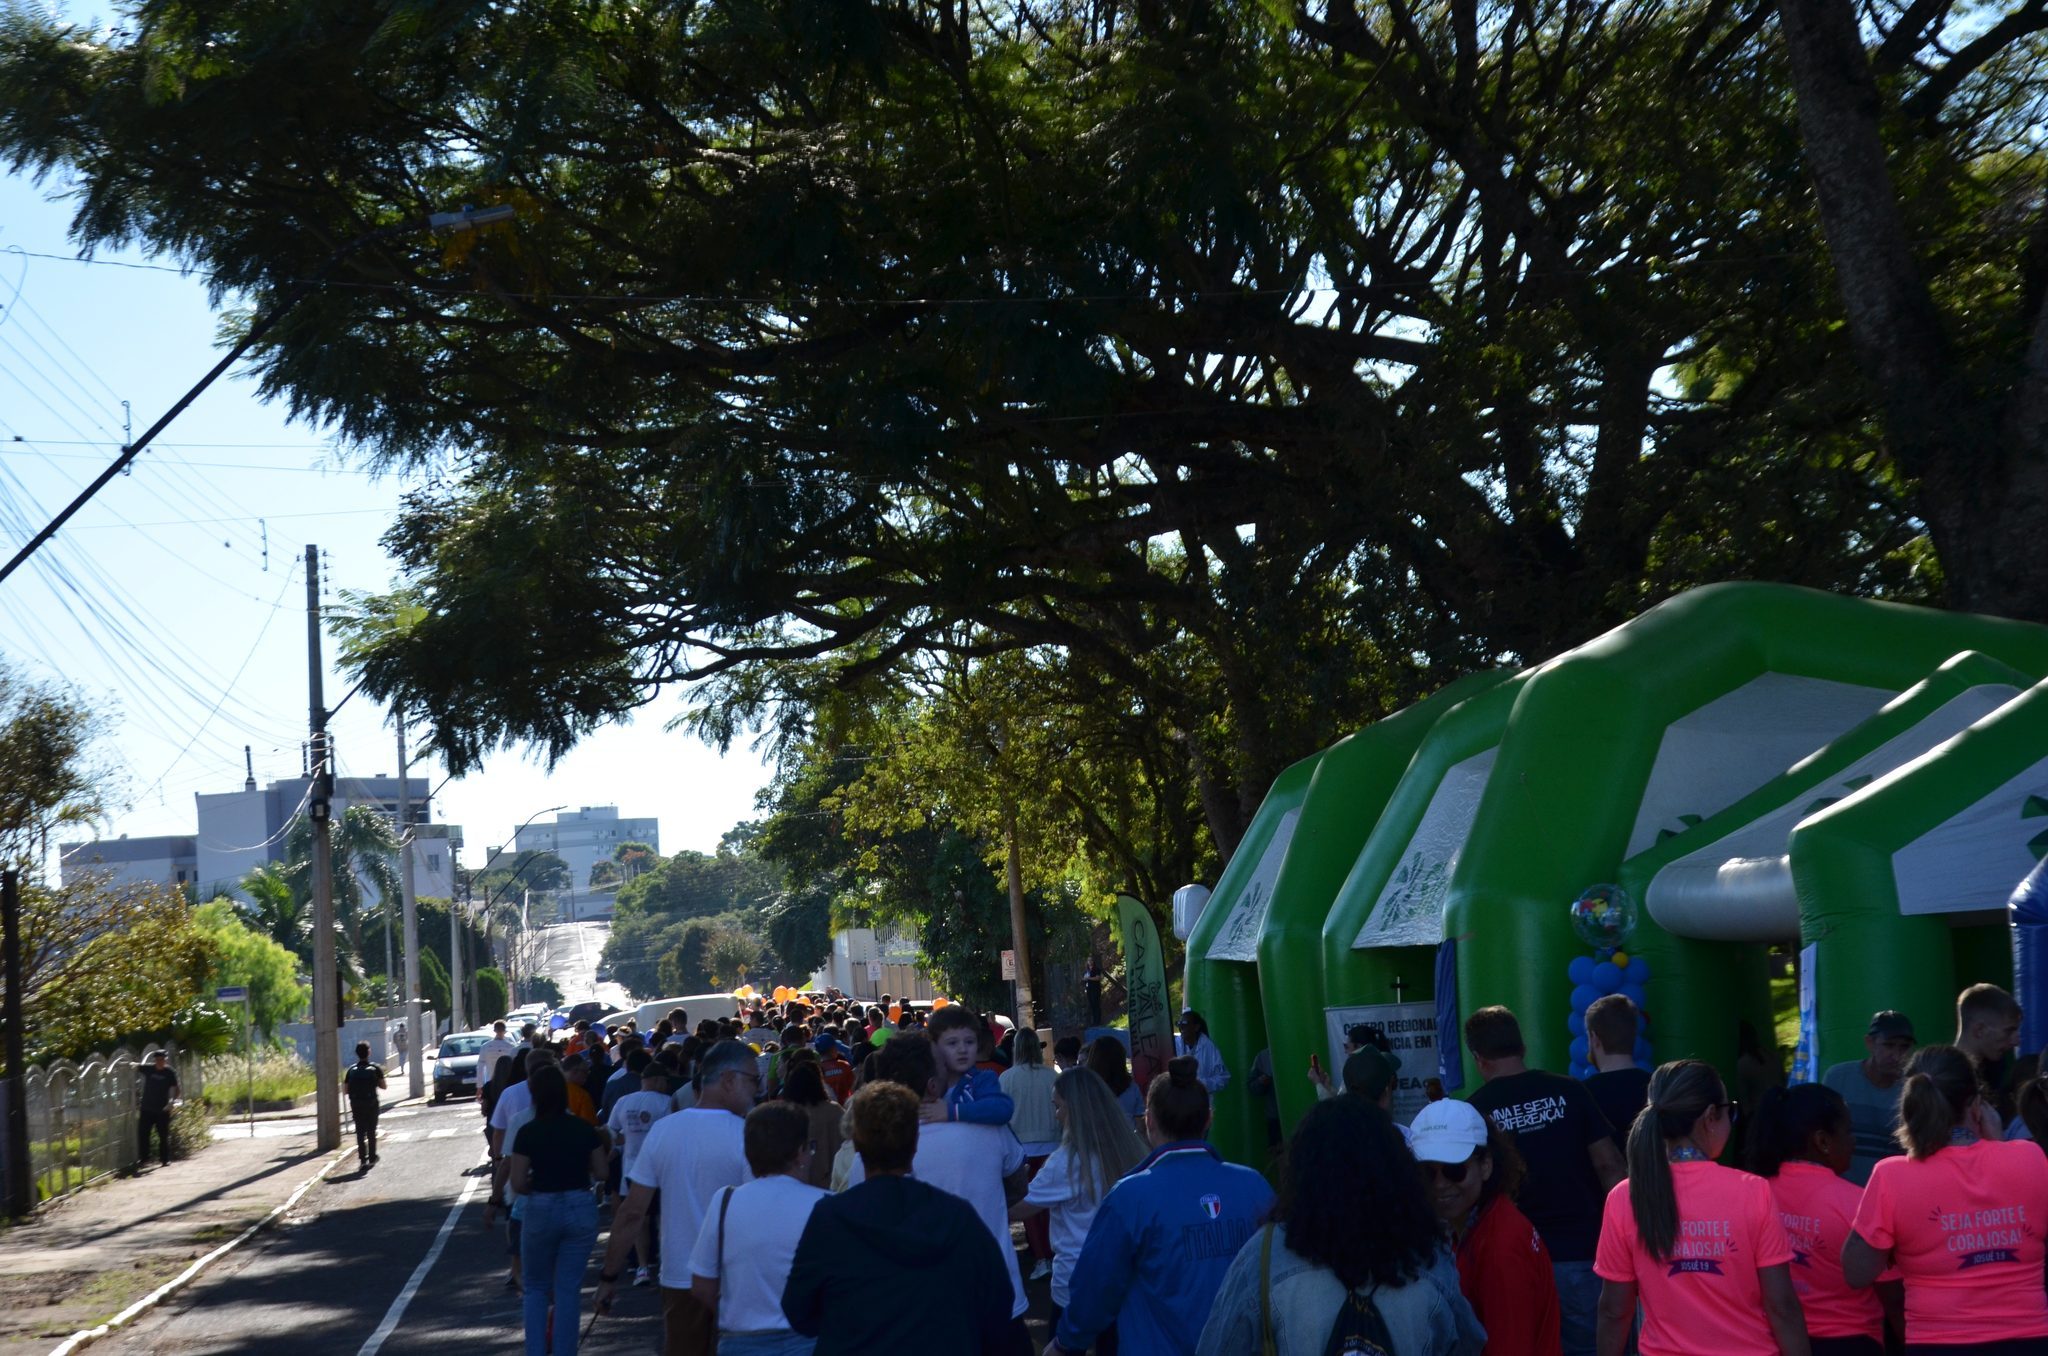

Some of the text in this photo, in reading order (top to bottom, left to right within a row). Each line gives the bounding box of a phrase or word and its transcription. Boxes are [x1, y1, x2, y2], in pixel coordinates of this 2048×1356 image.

[1414, 1035, 1432, 1049] EM
[1512, 1104, 1523, 1116] E
[1523, 1096, 1556, 1114] SEJA
[1558, 1095, 1567, 1107] A
[1681, 1220, 1730, 1237] FORTE E
[1780, 1212, 1821, 1234] ORTE E
[1940, 1205, 2027, 1231] SEJA FORTE E
[1673, 1241, 1725, 1257] RAJOSA!
[1947, 1228, 2023, 1251] CORAJOSA!
